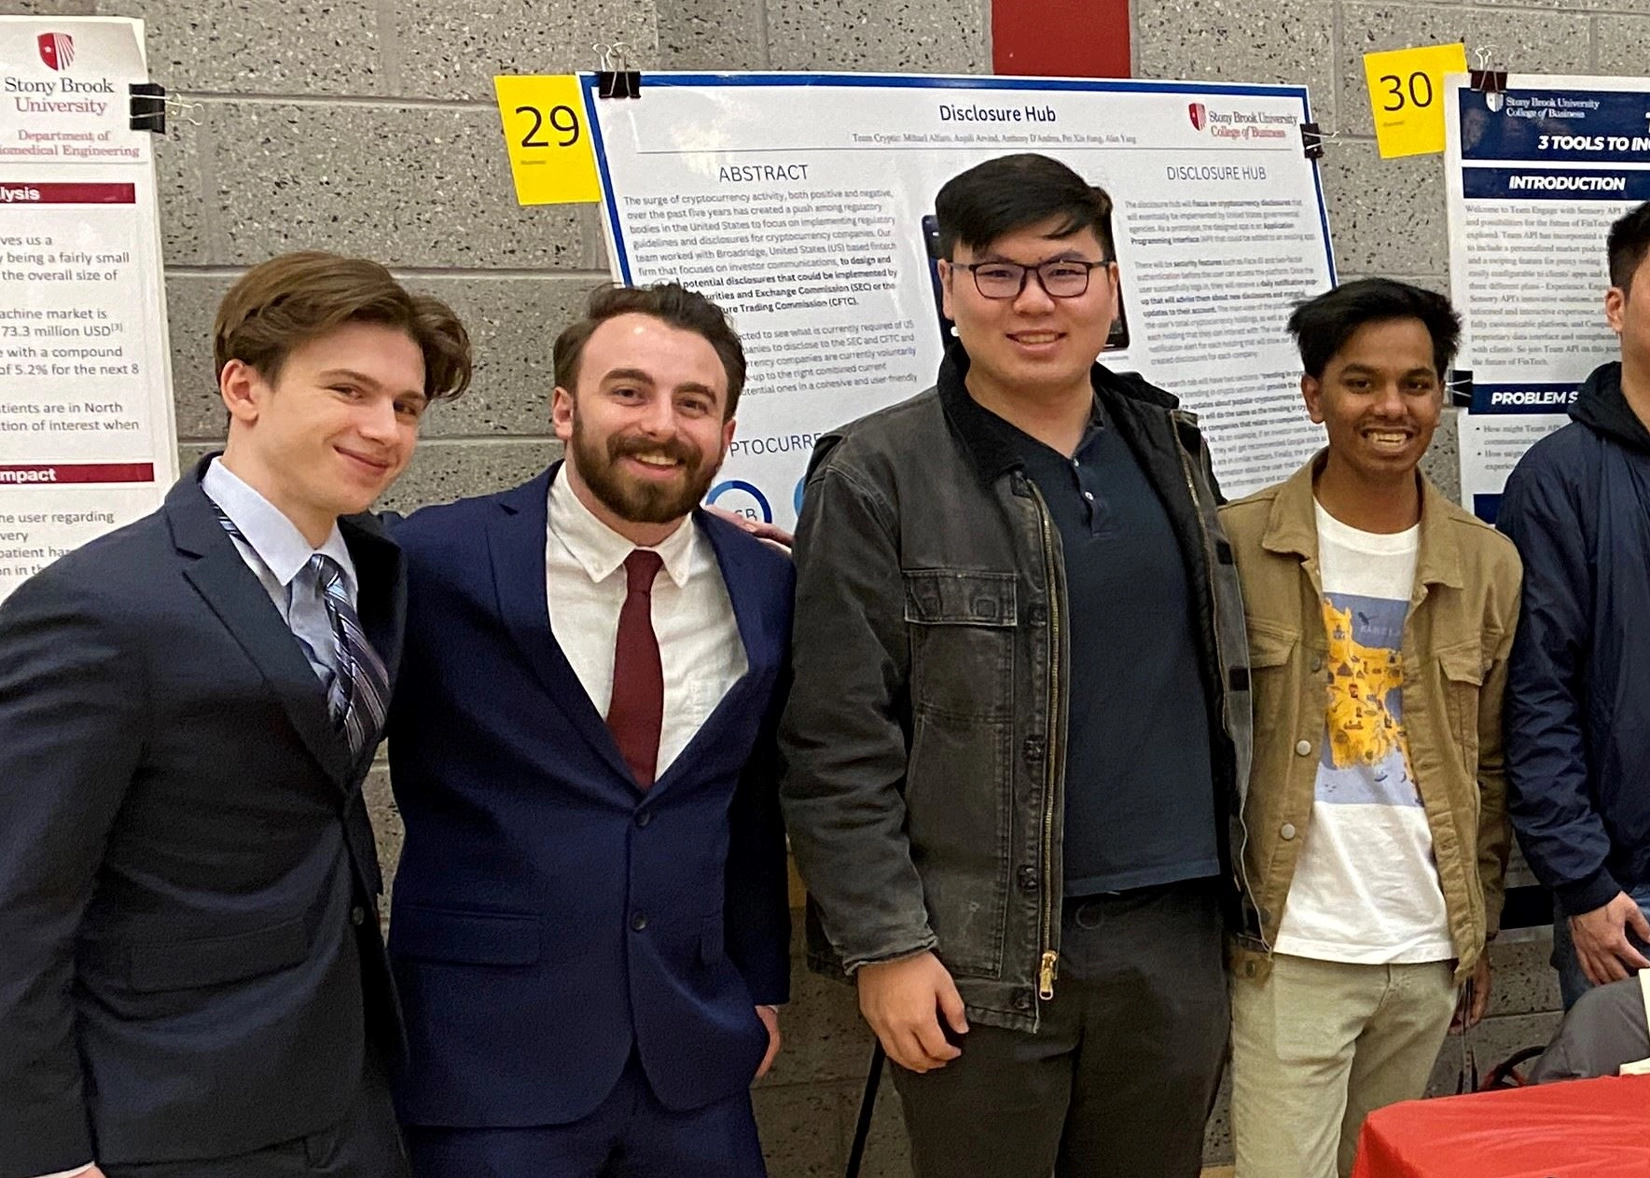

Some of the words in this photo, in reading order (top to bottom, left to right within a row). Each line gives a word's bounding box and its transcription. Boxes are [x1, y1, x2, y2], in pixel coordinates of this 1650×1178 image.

[5, 76, 58, 96] Stony
[60, 77, 114, 93] Brook
[1380, 71, 1433, 111] 30
[15, 97, 107, 116] University
[1506, 96, 1530, 109] Stony
[1531, 97, 1556, 107] Brook
[1557, 97, 1600, 110] University
[939, 105, 1022, 122] Disclosure
[1025, 105, 1056, 122] Hub
[1209, 111, 1233, 125] Stony
[1233, 111, 1259, 124] Brook
[1259, 112, 1298, 126] University
[1506, 108, 1537, 119] College
[1537, 108, 1548, 120] of
[1548, 109, 1585, 118] Business
[515, 105, 580, 148] 29
[1211, 126, 1241, 140] College
[1241, 126, 1251, 140] of
[1252, 126, 1286, 139] Business
[18, 129, 94, 142] Department
[97, 130, 111, 141] of
[1538, 135, 1550, 150] 3
[1551, 136, 1604, 151] TOOLS
[1607, 136, 1630, 151] TO
[63, 145, 140, 158] Engineering
[719, 164, 809, 183] ABSTRACT
[1167, 166, 1239, 180] DISCLOSURE
[1242, 166, 1267, 180] HUB
[1509, 175, 1626, 191] INTRODUCTION
[26, 236, 41, 246] us
[45, 236, 53, 246] a
[7, 251, 44, 266] being
[48, 254, 56, 264] a
[59, 251, 92, 266] fairly
[96, 251, 129, 264] small
[2, 269, 24, 281] the
[28, 269, 72, 281] overall
[76, 270, 100, 281] size
[104, 269, 118, 281] of
[683, 276, 725, 289] potential
[726, 274, 776, 286] disclosures
[777, 273, 795, 283] that
[797, 271, 821, 282] could
[823, 271, 834, 281] be
[704, 290, 735, 301] urities
[736, 289, 754, 299] and
[755, 286, 797, 298] Exchange
[798, 284, 849, 296] Commission
[872, 282, 882, 291] or
[46, 308, 94, 320] market
[97, 308, 107, 320] is
[740, 302, 774, 314] Trading
[2, 325, 30, 337] 73.3
[34, 325, 83, 337] million
[8, 346, 36, 358] with
[40, 348, 48, 358] a
[52, 346, 123, 360] compound
[15, 364, 48, 376] 5.2%
[52, 364, 70, 376] for
[74, 363, 96, 375] the
[100, 365, 128, 375] next
[131, 363, 140, 375] 8
[1491, 391, 1567, 405] PROBLEM
[43, 404, 65, 414] are
[69, 402, 81, 413] in
[85, 402, 123, 413] North
[32, 420, 46, 431] of
[50, 419, 100, 431] interest
[104, 419, 139, 431] when
[18, 513, 47, 523] user
[52, 511, 115, 525] regarding
